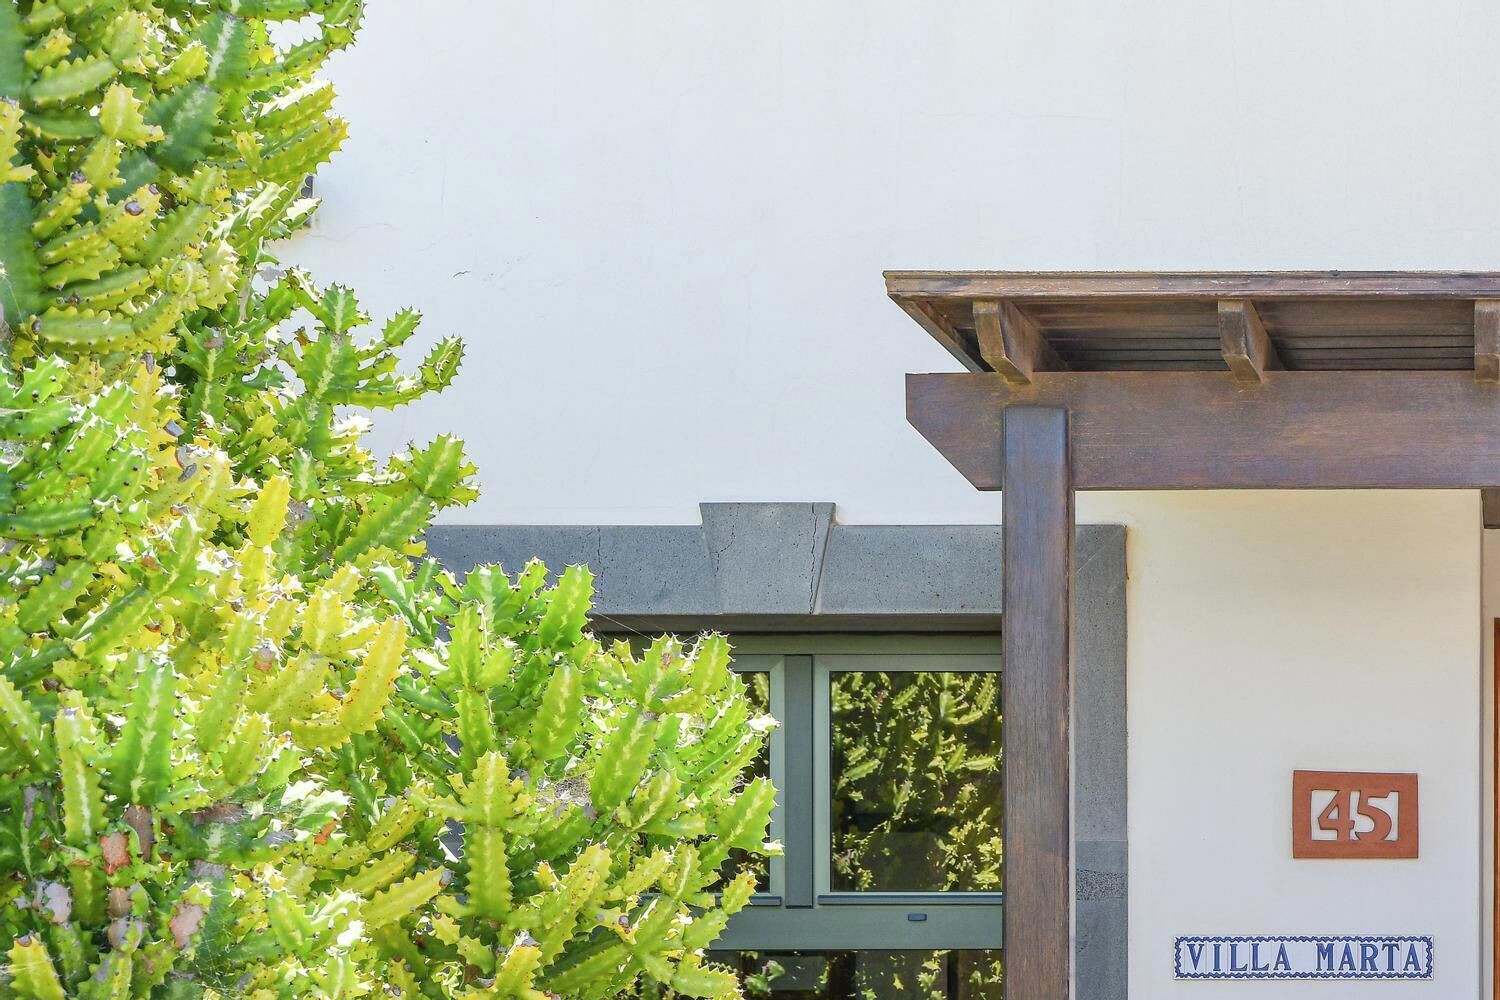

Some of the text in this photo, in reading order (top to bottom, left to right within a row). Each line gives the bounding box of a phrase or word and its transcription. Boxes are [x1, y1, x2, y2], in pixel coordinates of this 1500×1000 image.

[1317, 789, 1393, 842] 45
[1186, 942, 1422, 972] VILLA MARTA
